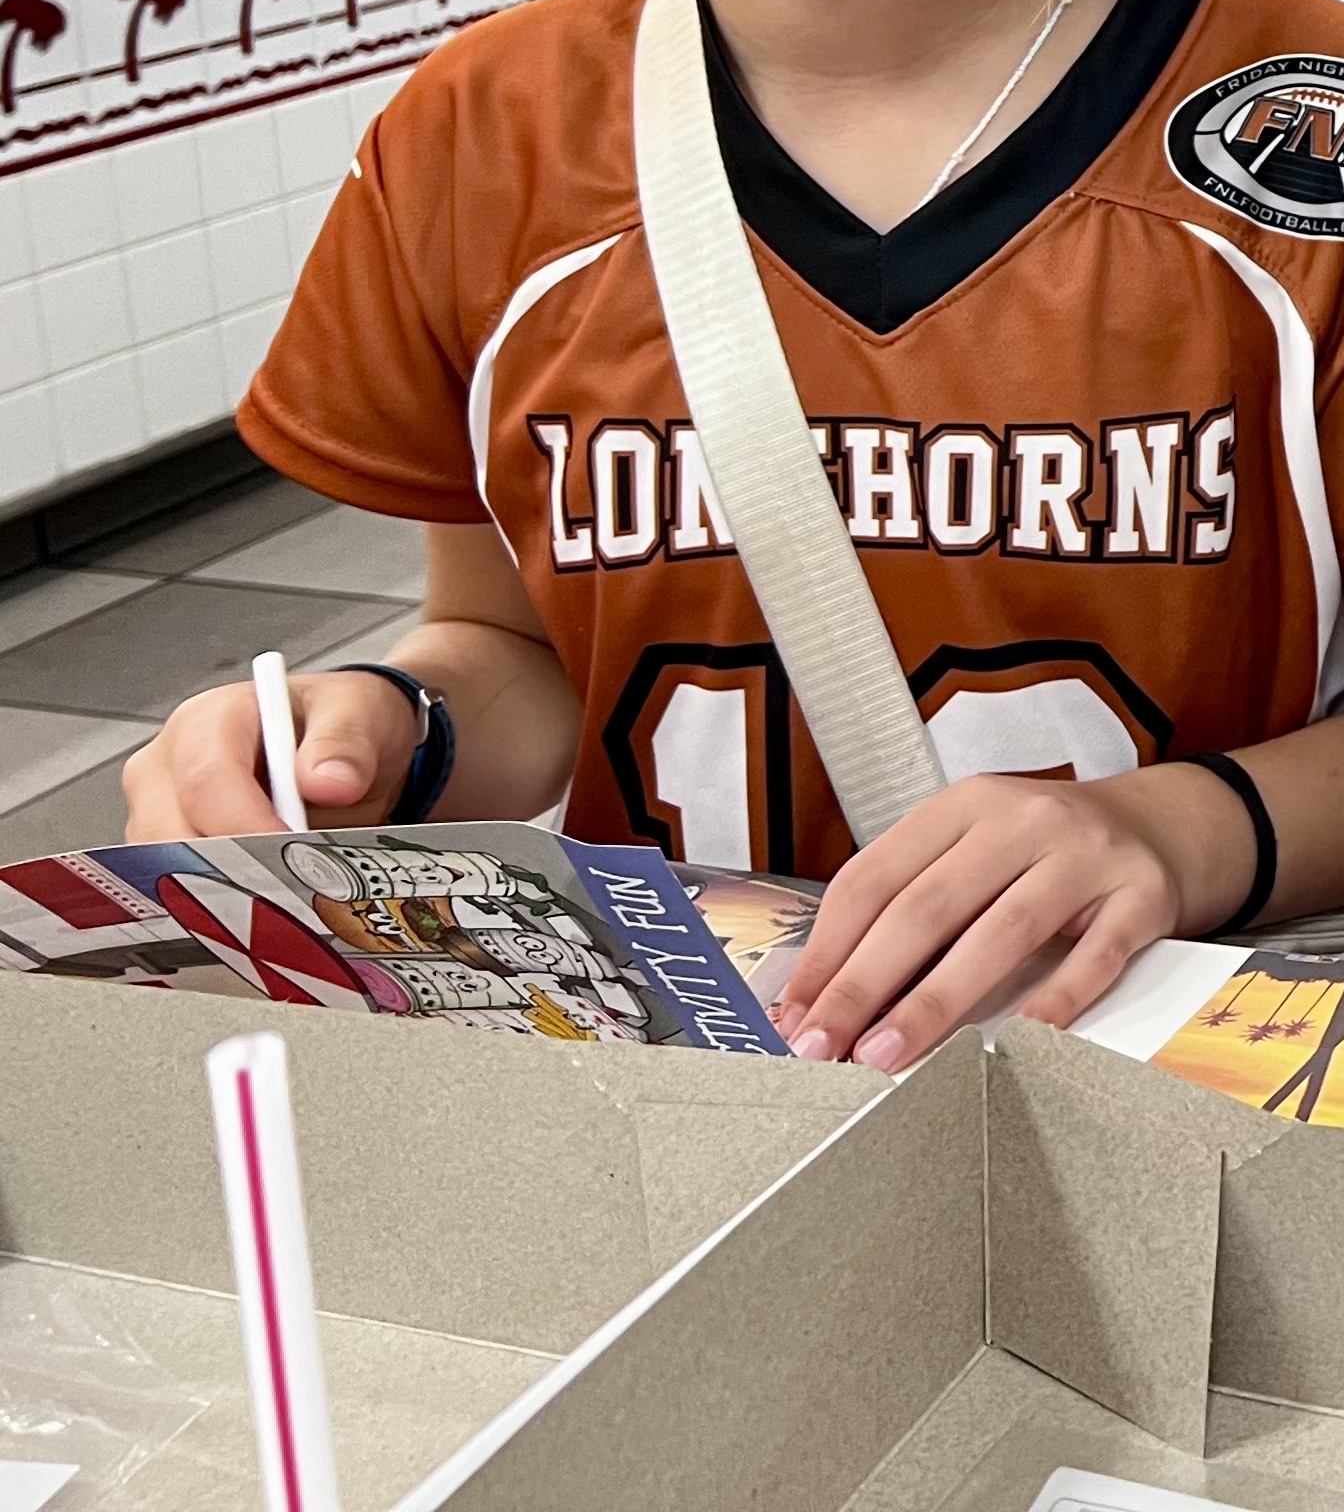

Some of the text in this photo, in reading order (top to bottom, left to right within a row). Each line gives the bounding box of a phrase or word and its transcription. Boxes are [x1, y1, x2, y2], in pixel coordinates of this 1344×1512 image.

[1214, 61, 1291, 98] FRIDAY
[528, 400, 1235, 573] LONHORNS
[586, 865, 795, 1058] TIVITY FUN
